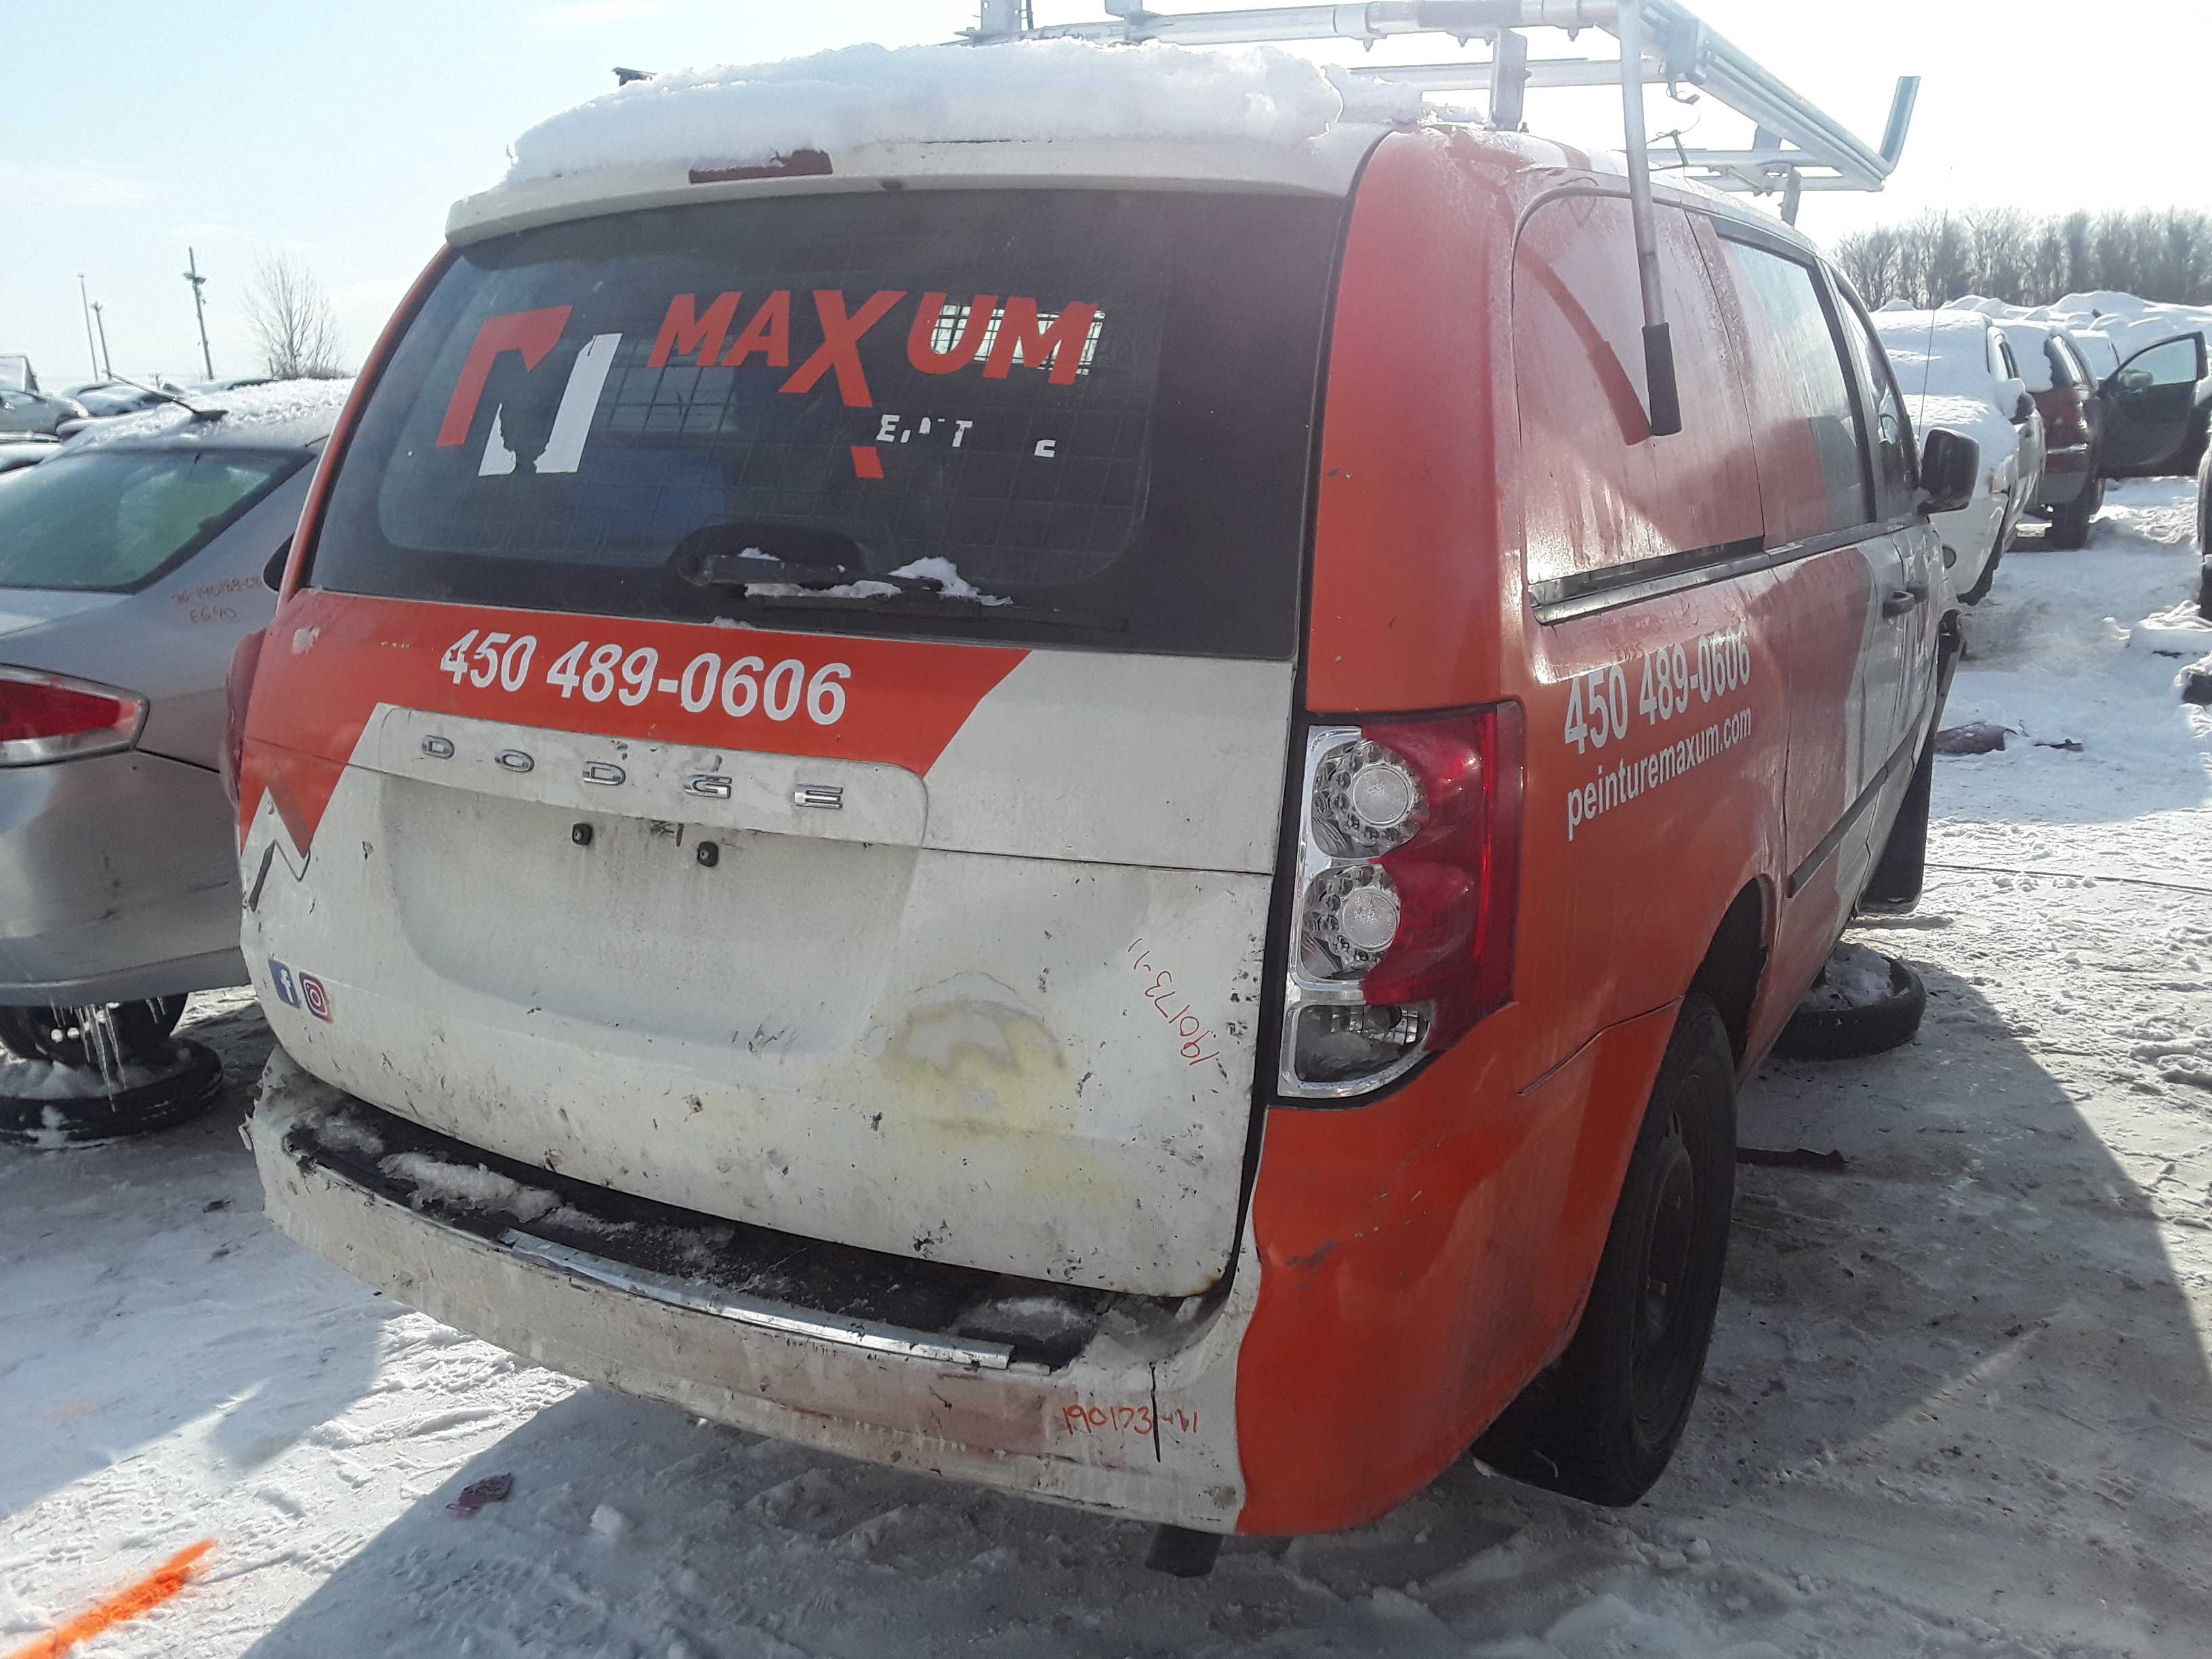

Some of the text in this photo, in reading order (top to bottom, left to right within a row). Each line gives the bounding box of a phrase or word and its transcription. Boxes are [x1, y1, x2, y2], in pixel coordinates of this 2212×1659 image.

[647, 289, 1097, 407] MAXUM
[440, 629, 852, 725] 450 489-0606
[1565, 620, 1750, 755] 450 489-0606
[422, 735, 843, 810] DODGE
[1567, 708, 1752, 841] peinturemaxum.com
